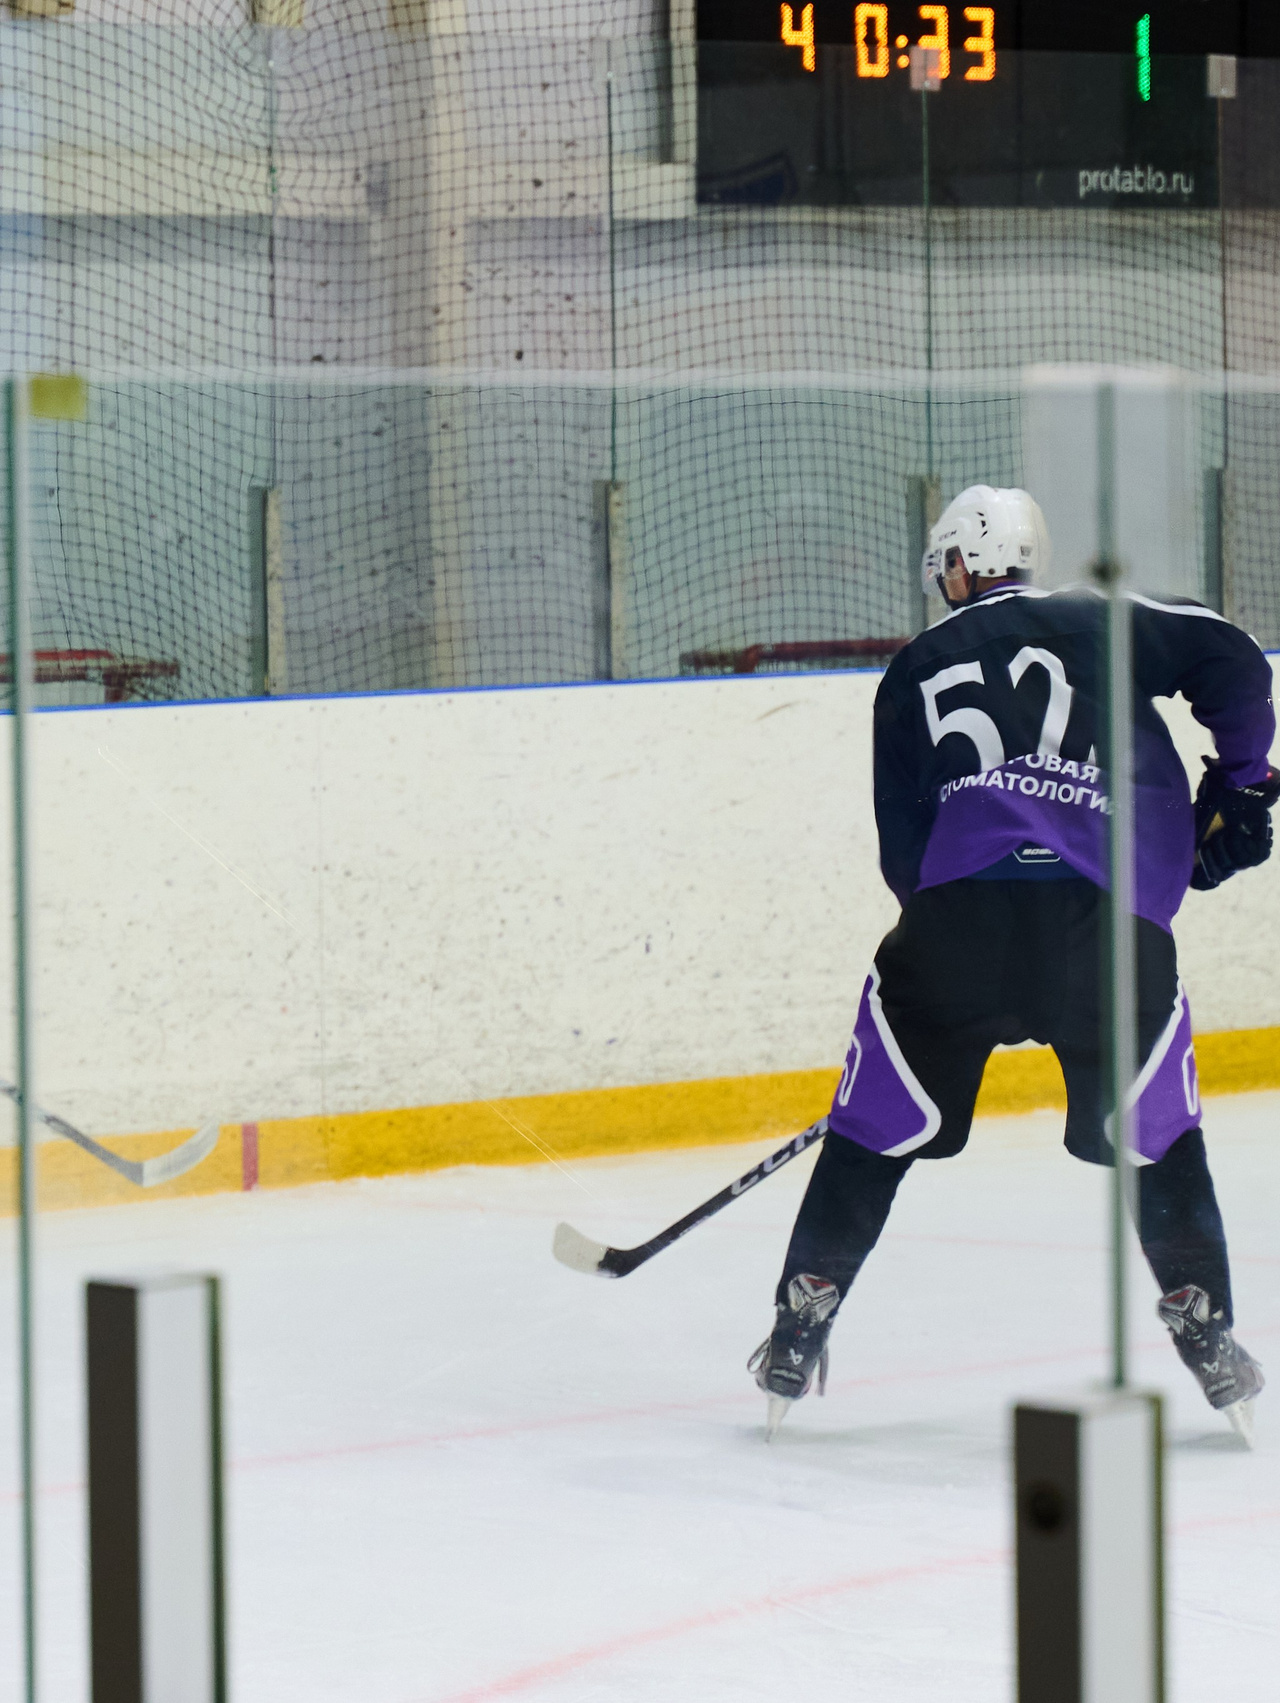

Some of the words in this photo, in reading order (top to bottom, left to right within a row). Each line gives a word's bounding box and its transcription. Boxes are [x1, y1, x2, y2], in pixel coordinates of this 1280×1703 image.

[781, 3, 815, 72] 4
[855, 3, 996, 81] 0:33
[1136, 13, 1150, 101] 1
[1078, 165, 1195, 199] protablo.ru
[920, 646, 1098, 773] 52
[1008, 753, 1102, 784] ОВАЯ
[731, 1115, 828, 1196] CCM
